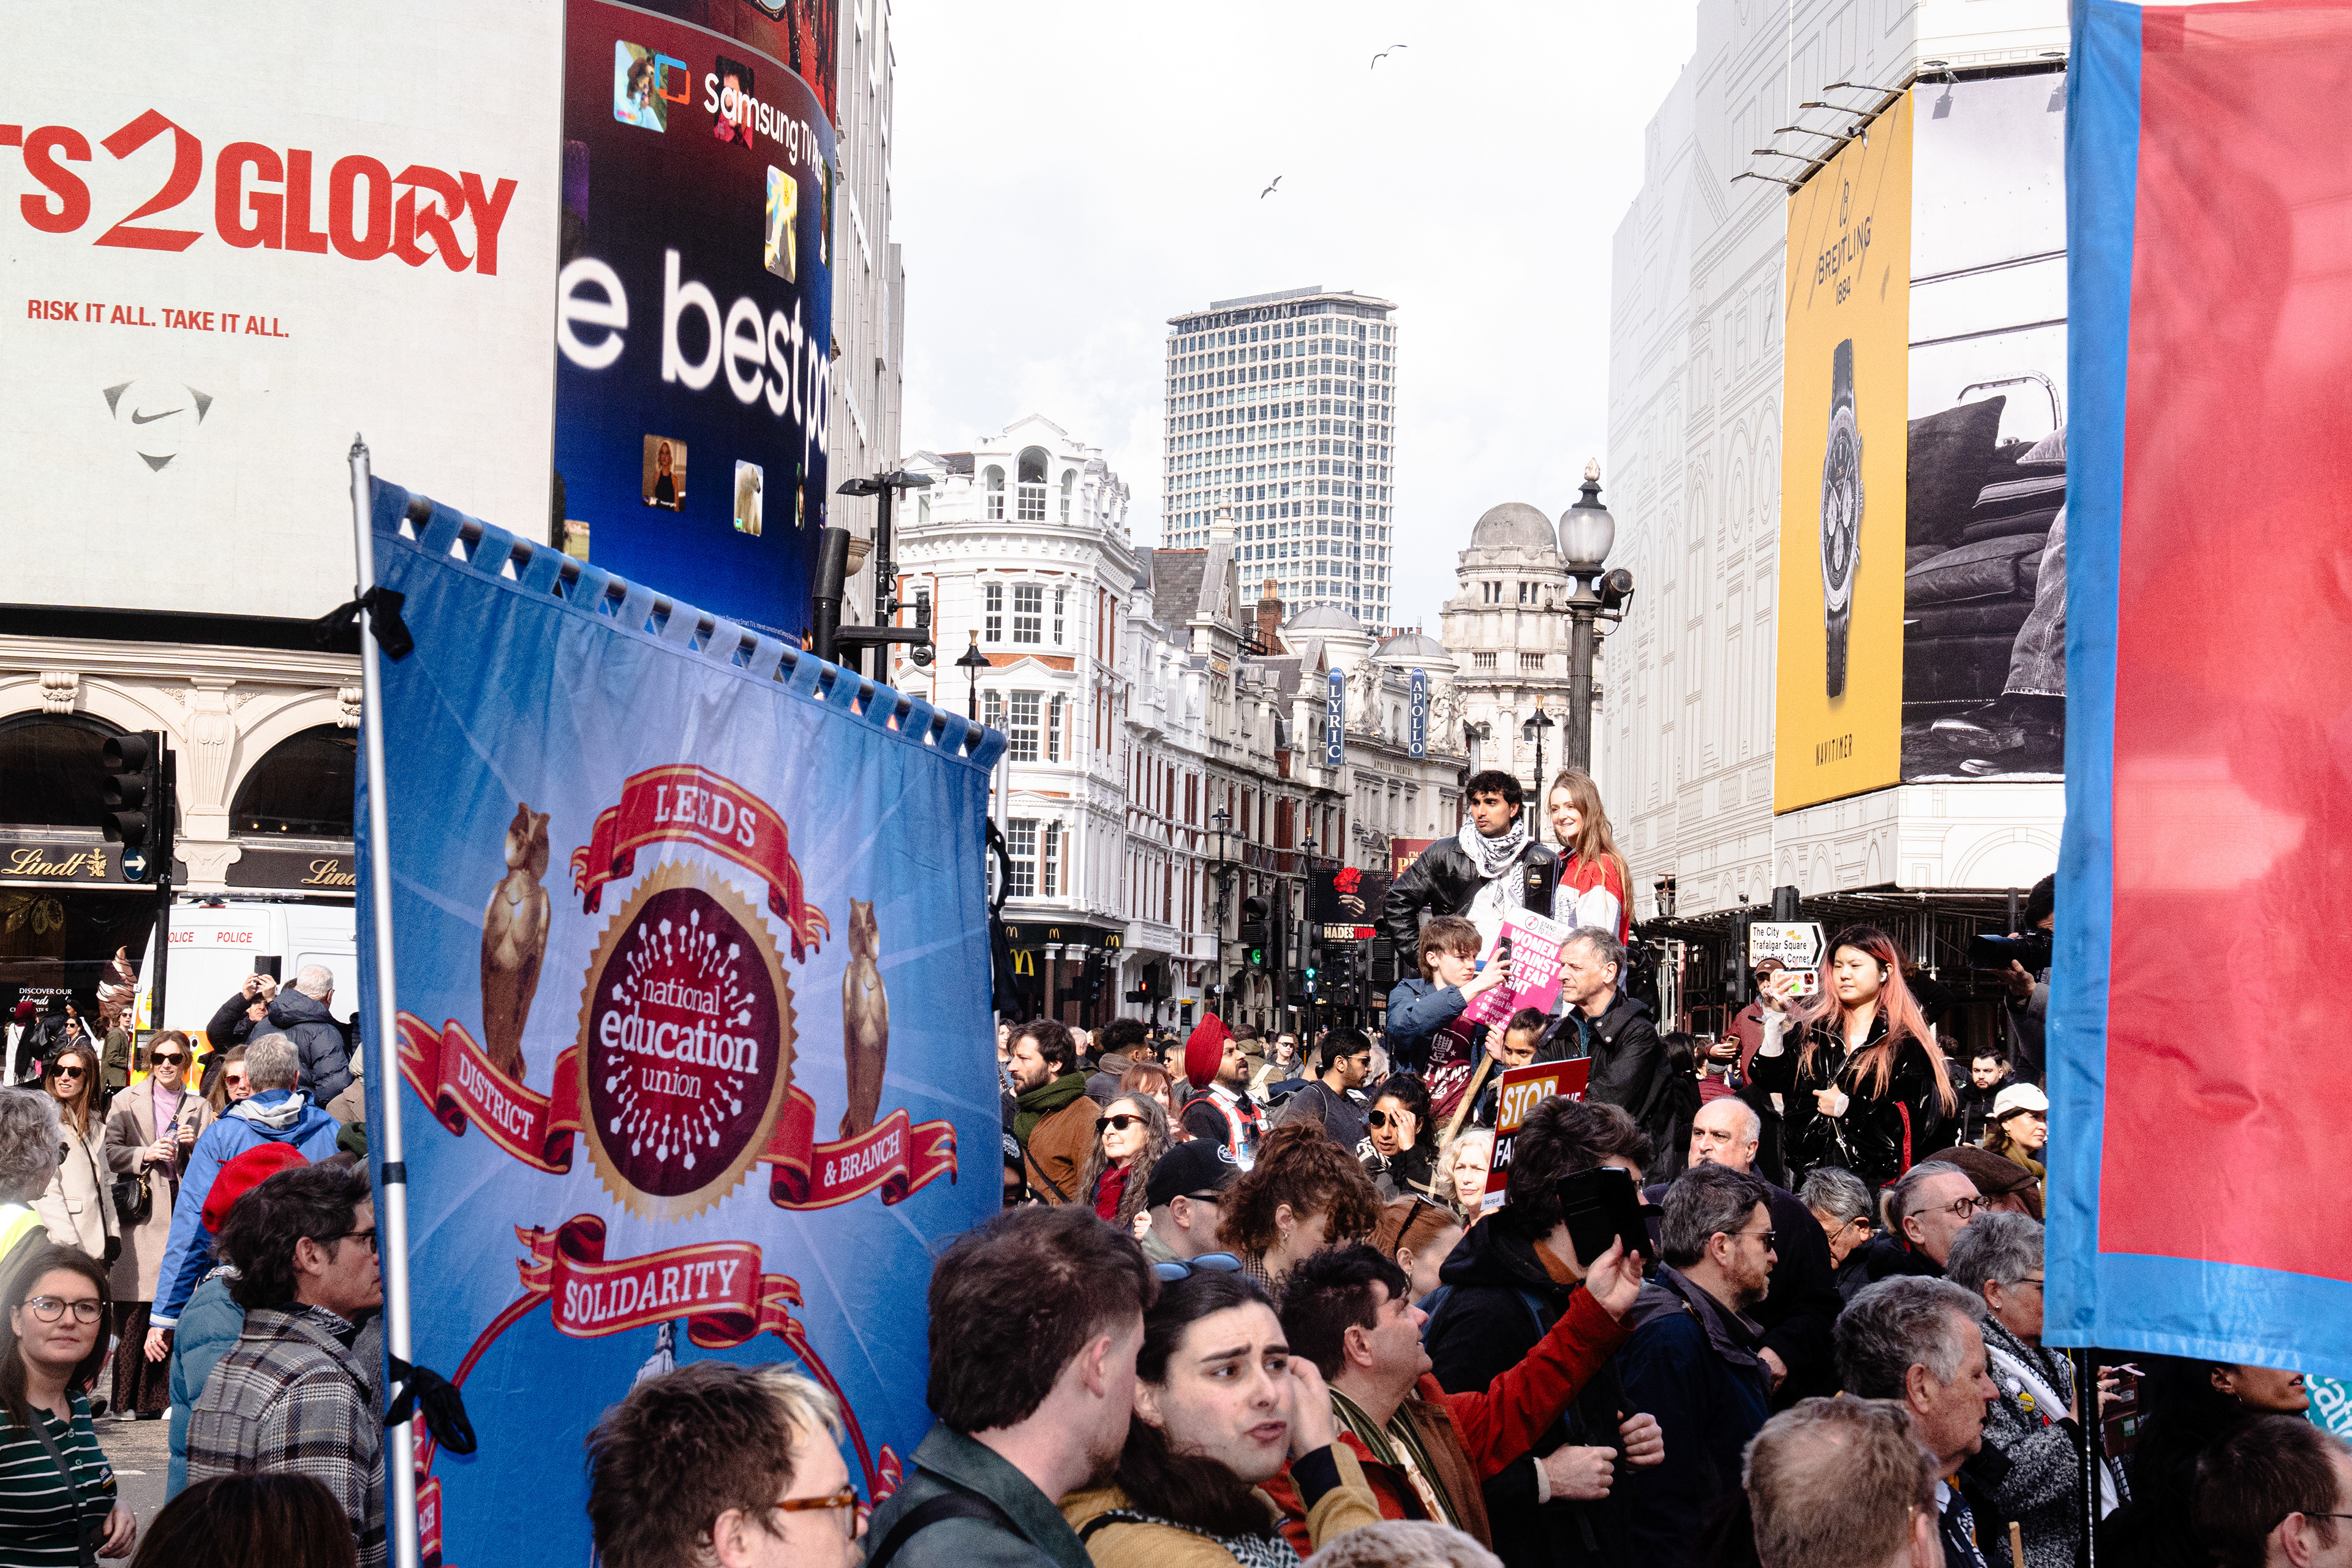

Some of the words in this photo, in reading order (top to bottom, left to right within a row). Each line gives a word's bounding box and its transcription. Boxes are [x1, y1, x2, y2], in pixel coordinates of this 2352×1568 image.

[704, 72, 798, 165] Samsung
[801, 119, 812, 165] TV
[812, 134, 823, 185] Plus
[92, 108, 205, 252] 2
[214, 141, 518, 277] GLORY
[1819, 216, 1871, 285] BREITLING
[1836, 276, 1850, 306] 1884
[28, 299, 79, 322] RISK
[86, 303, 106, 323] IT
[110, 304, 157, 328] ALL.
[162, 307, 214, 332] TAKE
[222, 313, 241, 334] IT
[244, 314, 290, 339] ALL.
[1183, 312, 1236, 334] CENTRE
[1249, 304, 1302, 323] POINT
[662, 248, 803, 425] best
[1328, 685, 1341, 758] LYRIC
[1411, 681, 1423, 753] APOLLO
[1815, 734, 1852, 767] NAVITIMER
[1374, 760, 1391, 772] APOLLO
[1394, 764, 1413, 777] THEATRE
[654, 783, 756, 848] LEEDS
[1, 848, 87, 877] Lindt
[168, 932, 194, 943] OLICE
[217, 932, 253, 943] POLICE
[1540, 921, 1556, 932] STAND
[1753, 927, 1764, 936] The
[1766, 927, 1779, 938] City
[1510, 927, 1559, 960] WOMEN
[1512, 943, 1561, 976] GAINST
[1753, 940, 1781, 951] Trafalgar
[1784, 940, 1807, 951] Square
[1505, 976, 1532, 995] GHT
[1523, 967, 1550, 988] FAR
[642, 976, 722, 1017] national
[1480, 1002, 1511, 1021] Refugees
[1484, 995, 1505, 1008] racist
[1504, 1002, 1517, 1013] lies
[1476, 1012, 1489, 1022] not
[600, 1008, 759, 1075] education
[458, 1055, 534, 1144] DISTRICT
[641, 1066, 701, 1100] union
[824, 1164, 837, 1188] &
[839, 1130, 902, 1186] BRANCH
[1493, 1136, 1518, 1169] FA
[564, 1257, 739, 1325] SOLIDARITY
